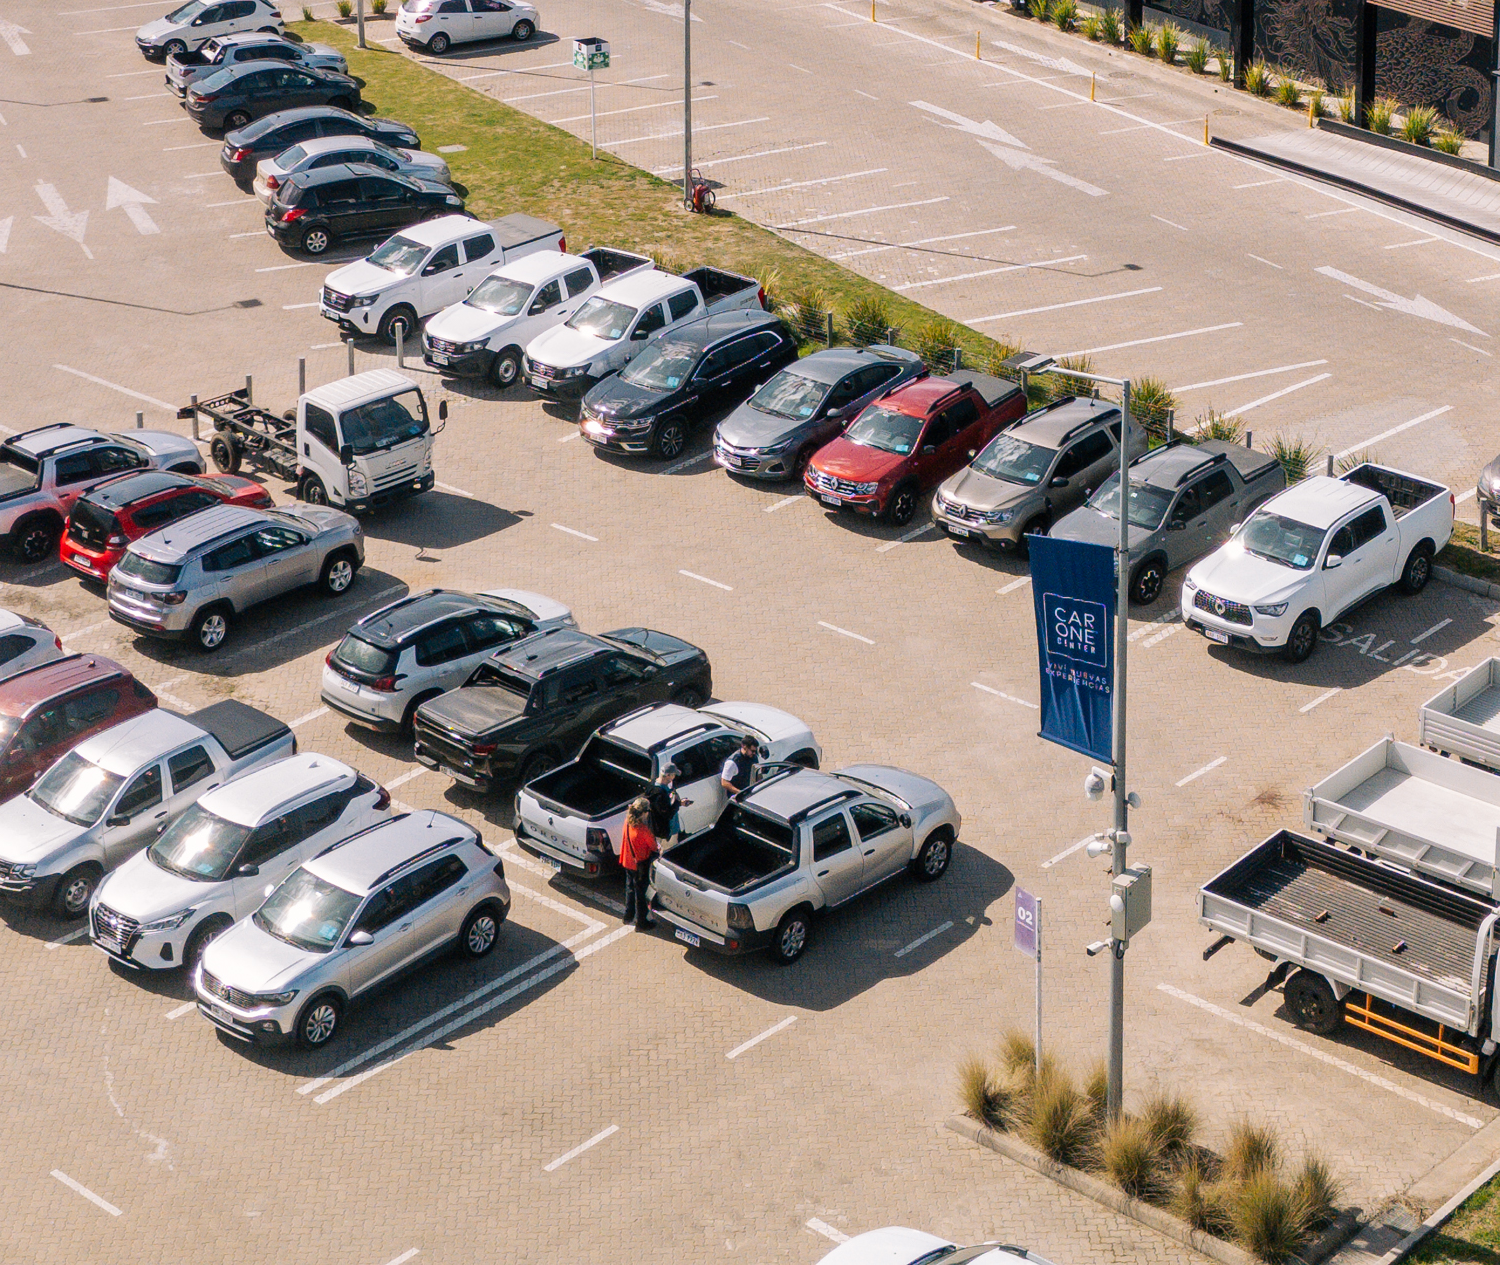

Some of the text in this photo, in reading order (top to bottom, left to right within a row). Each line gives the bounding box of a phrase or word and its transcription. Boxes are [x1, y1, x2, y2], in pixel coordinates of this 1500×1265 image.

[1054, 607, 1096, 628] CAR
[1055, 622, 1096, 645] ONE
[1057, 637, 1096, 655] CENTER
[1320, 622, 1475, 680] SALIDA
[1045, 667, 1111, 694] EXPERIENCIAS
[665, 896, 719, 927] OROCH
[1018, 905, 1033, 925] 02
